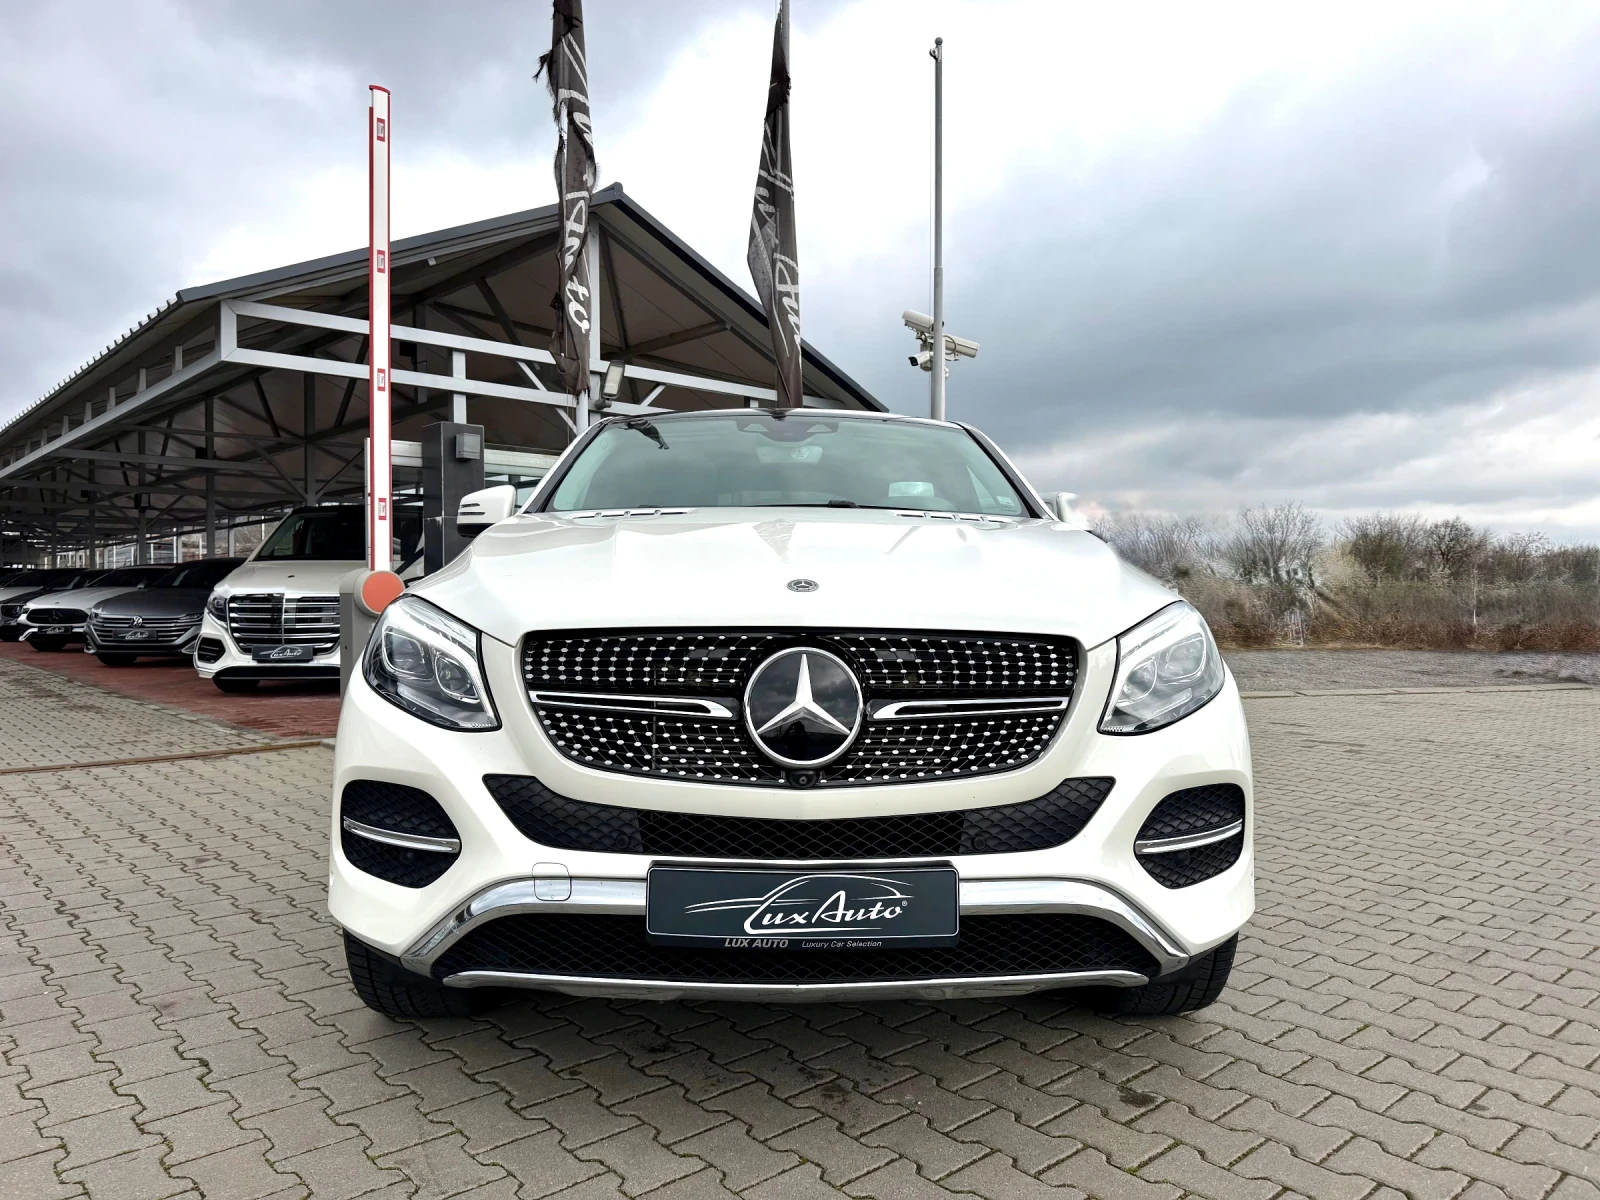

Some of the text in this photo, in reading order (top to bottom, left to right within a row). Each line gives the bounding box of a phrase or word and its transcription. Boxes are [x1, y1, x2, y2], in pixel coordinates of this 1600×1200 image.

[724, 938, 750, 948] LUX
[752, 939, 789, 948] AUTO
[802, 941, 828, 949] Luxury
[846, 940, 882, 948] Selection
